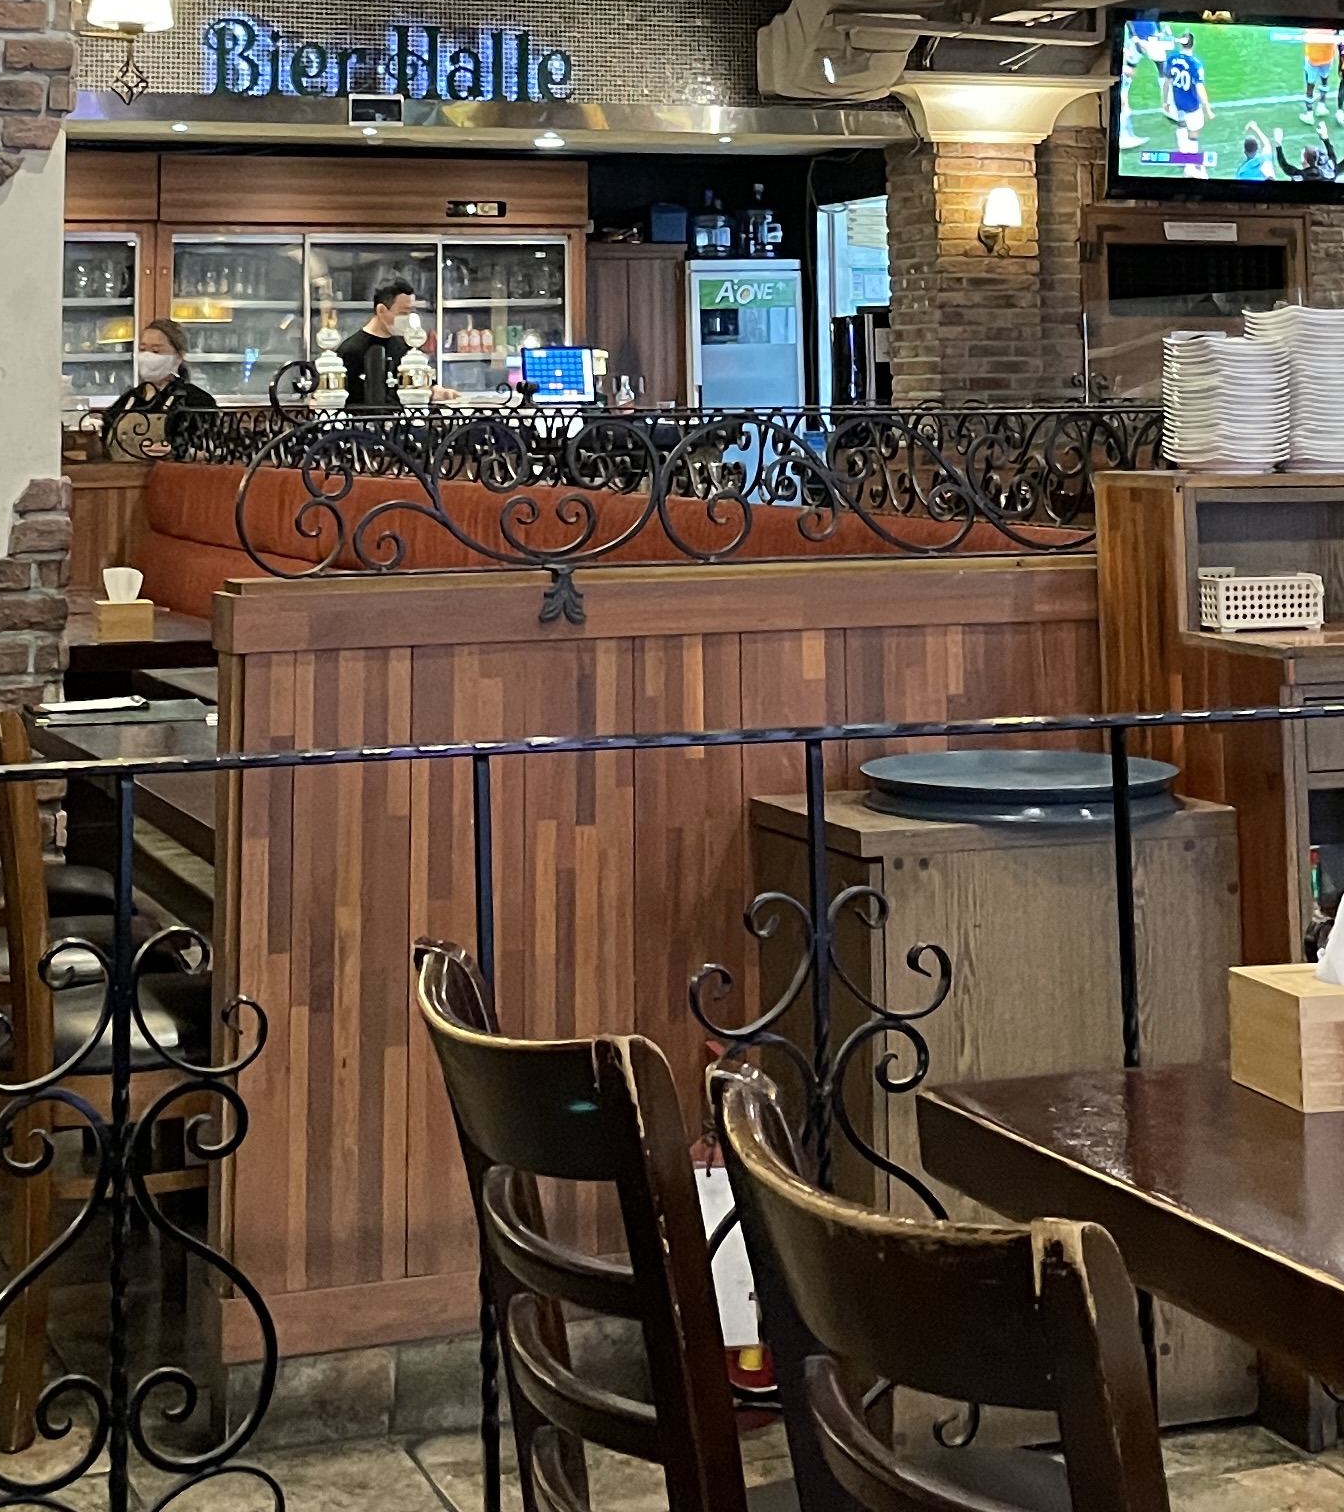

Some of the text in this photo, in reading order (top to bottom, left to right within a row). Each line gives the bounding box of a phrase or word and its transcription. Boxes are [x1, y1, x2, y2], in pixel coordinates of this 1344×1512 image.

[205, 17, 573, 102] Bier Halle
[1171, 67, 1191, 91] 20
